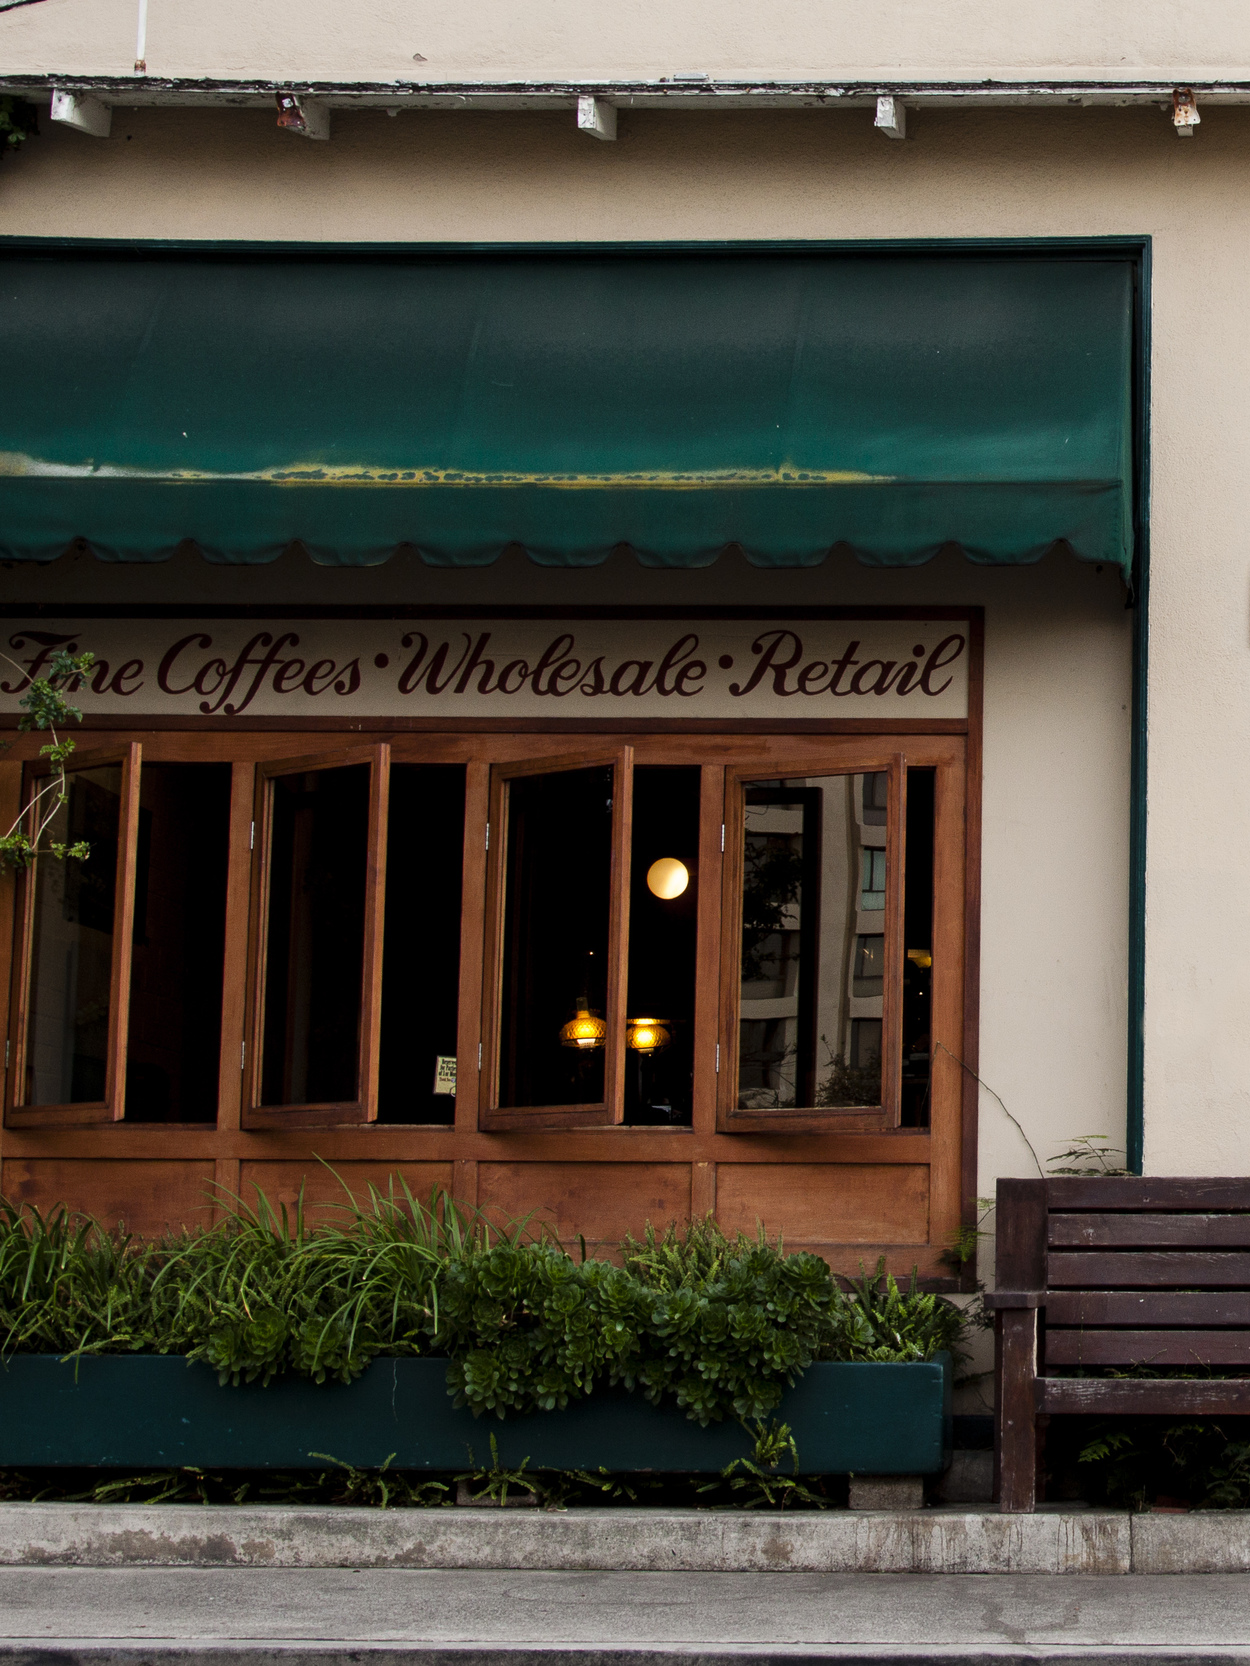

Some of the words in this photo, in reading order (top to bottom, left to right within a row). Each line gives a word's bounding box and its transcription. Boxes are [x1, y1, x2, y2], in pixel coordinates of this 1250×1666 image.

[157, 632, 361, 716] Coffees
[397, 631, 707, 697] Wholesale
[729, 629, 966, 697] Retail
